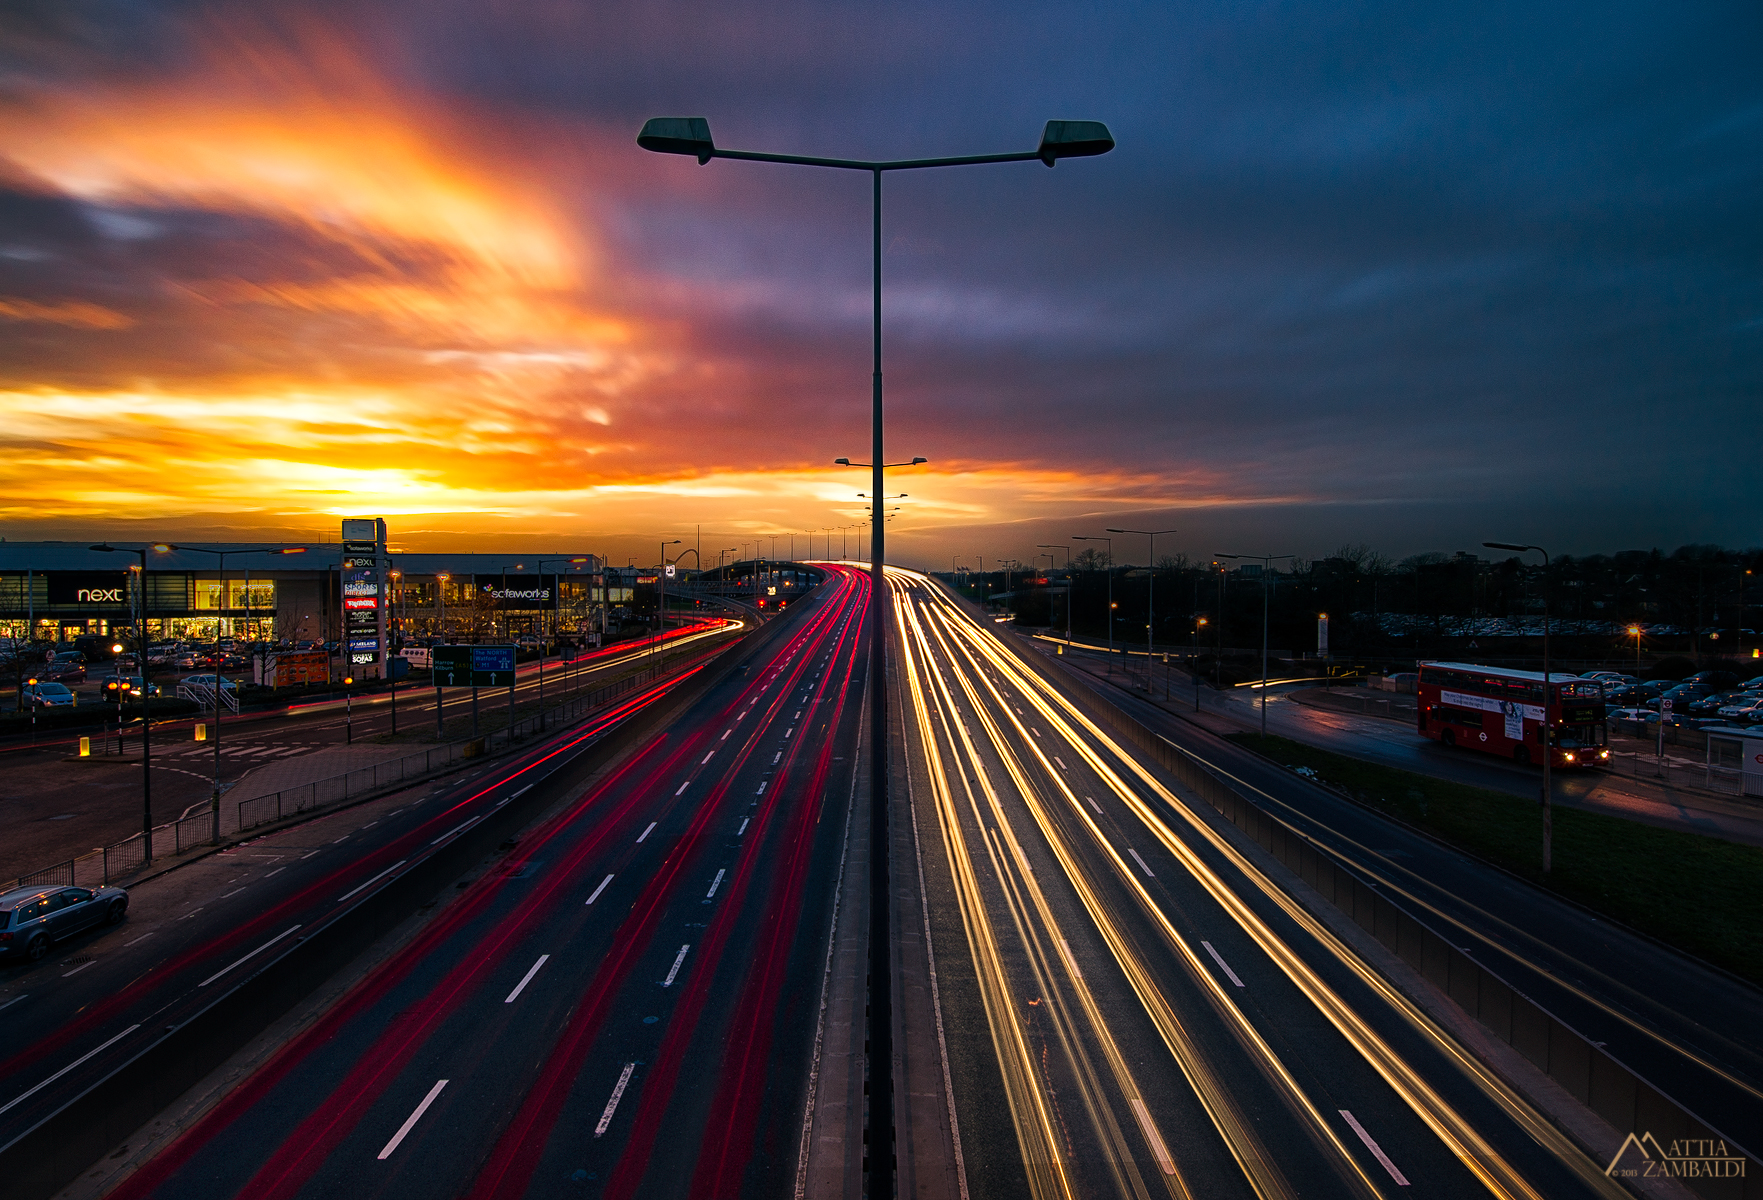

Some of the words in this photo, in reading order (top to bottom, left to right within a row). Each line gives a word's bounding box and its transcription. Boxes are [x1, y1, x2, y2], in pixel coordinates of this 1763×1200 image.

[349, 558, 375, 567] next
[346, 583, 377, 591] SPORTS
[77, 588, 124, 602] next
[491, 588, 550, 599] sofaworks
